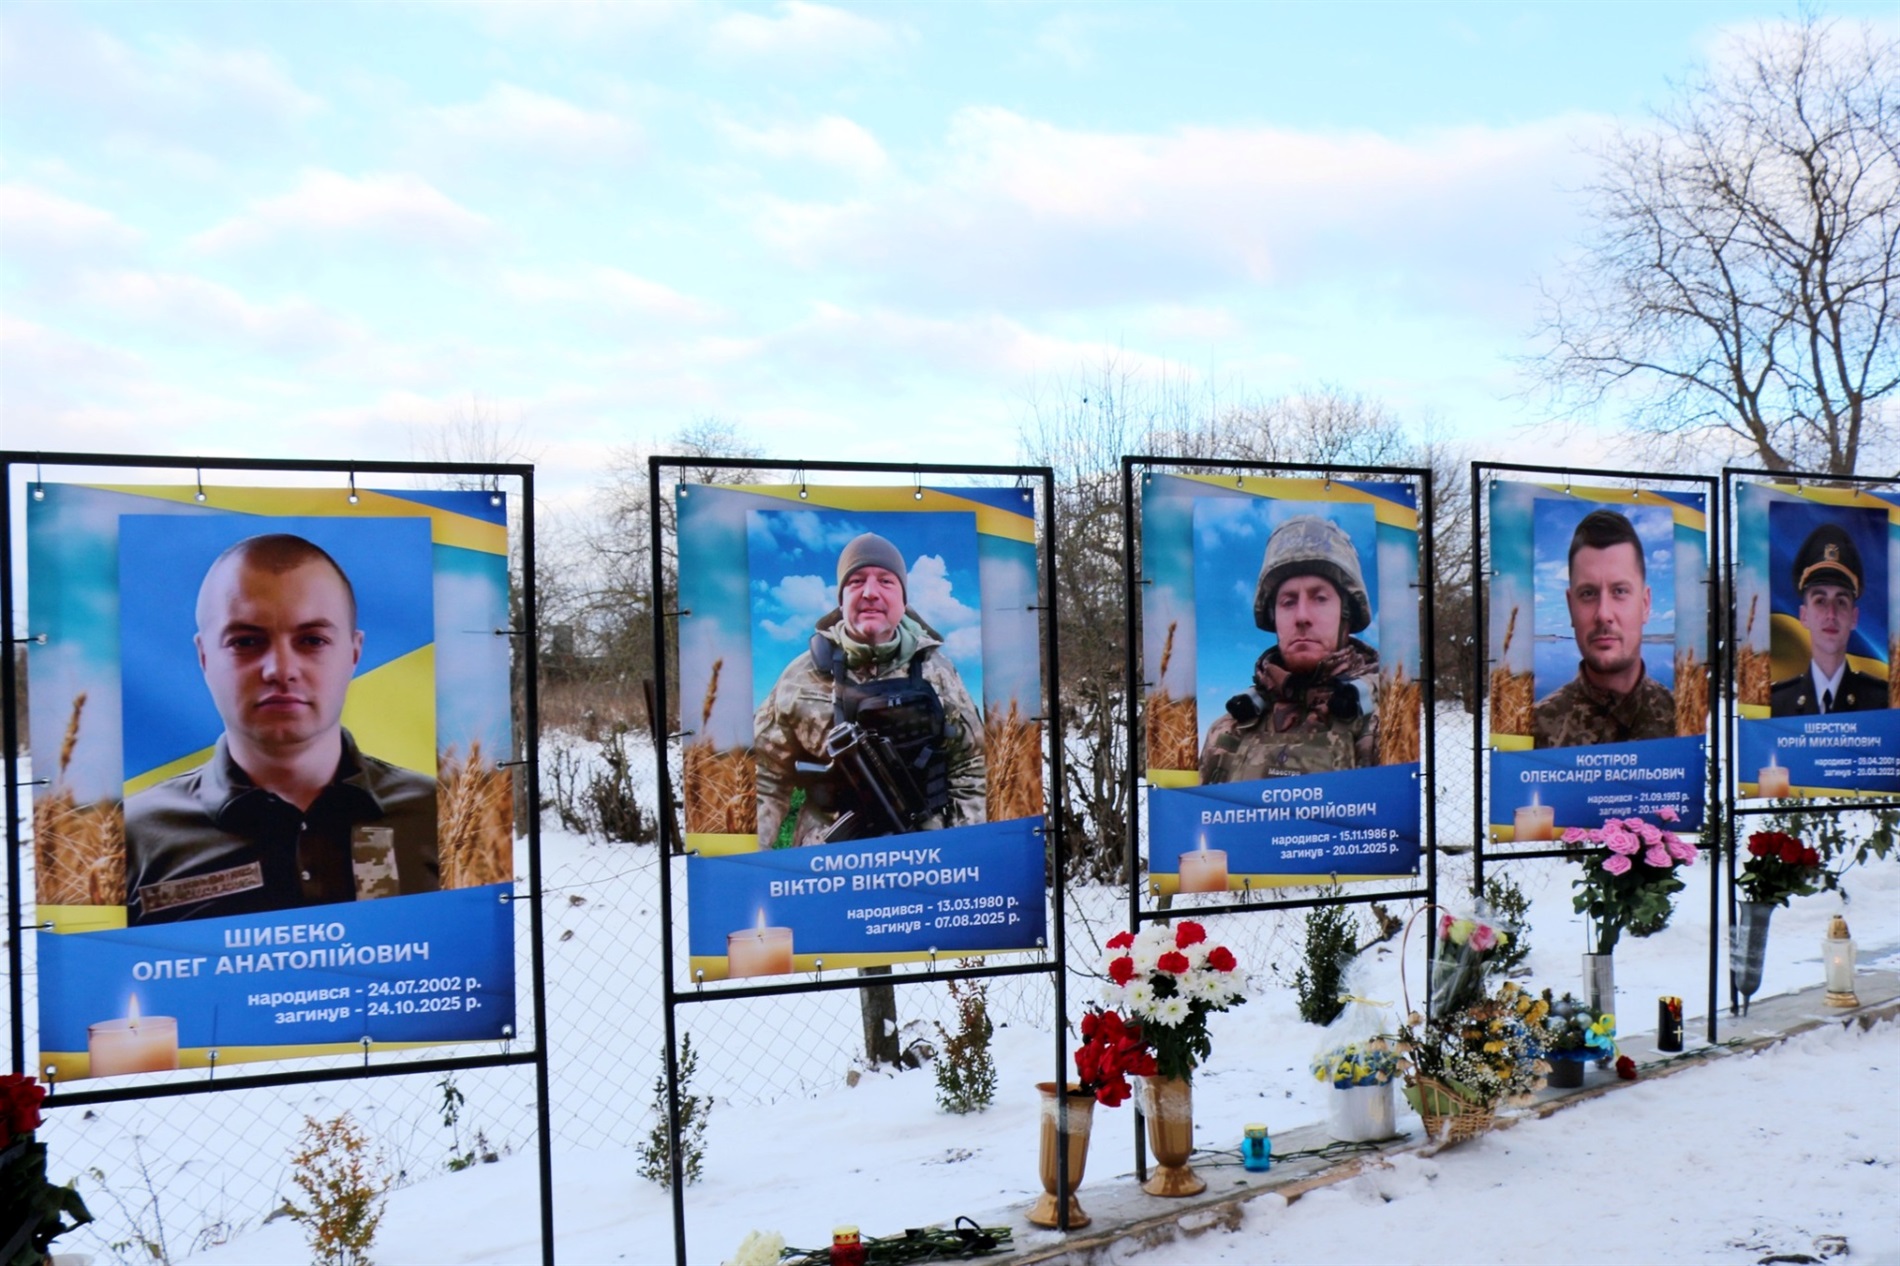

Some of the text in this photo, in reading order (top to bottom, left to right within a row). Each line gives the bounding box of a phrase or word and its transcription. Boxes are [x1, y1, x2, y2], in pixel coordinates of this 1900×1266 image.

[1805, 723, 1856, 733] ШЕРСТЮК
[1777, 735, 1881, 747] ЮРІЙ МИХАЙЛОВИЧ
[1576, 754, 1637, 766] КОСТІРОВ
[1520, 768, 1684, 783] ОЛЕКСАНДР ВАСИЛЬОВИЧ
[1262, 787, 1323, 803] ЄГОРОВ
[1588, 795, 1633, 804] народився
[1682, 793, 1689, 802] р.
[1201, 802, 1376, 825] ВАЛЕНТИН ЮРІЙОВИЧ
[1599, 807, 1631, 816] загинув
[1681, 805, 1689, 814] р.
[1272, 834, 1330, 846] народився
[1340, 828, 1387, 841] 15.11.1986
[1389, 830, 1399, 840] р.
[810, 848, 942, 872] СМОЛЯРЧУК
[1281, 848, 1323, 859] загинув
[1333, 842, 1387, 855] 20.01.2025
[1390, 844, 1399, 854] р.
[770, 867, 979, 897] ВІКТОР ВІКТОРОВИЧ
[847, 904, 923, 920] народився
[937, 896, 1003, 912] 13.03.1980
[1007, 897, 1018, 908] р.
[866, 921, 921, 934] загинув
[935, 912, 1005, 928] 07.08.2025
[1009, 913, 1020, 925] р.
[225, 923, 346, 948] ШИБЕКО
[133, 941, 430, 981] ОЛЕГ АНАТОЛІЙОВИЧ
[248, 987, 350, 1007] народився
[368, 977, 461, 996] 24.07.2002
[466, 978, 481, 992] р.
[275, 1007, 350, 1024] загинув
[368, 996, 461, 1016] 24.10.2025
[466, 997, 481, 1011] р.
